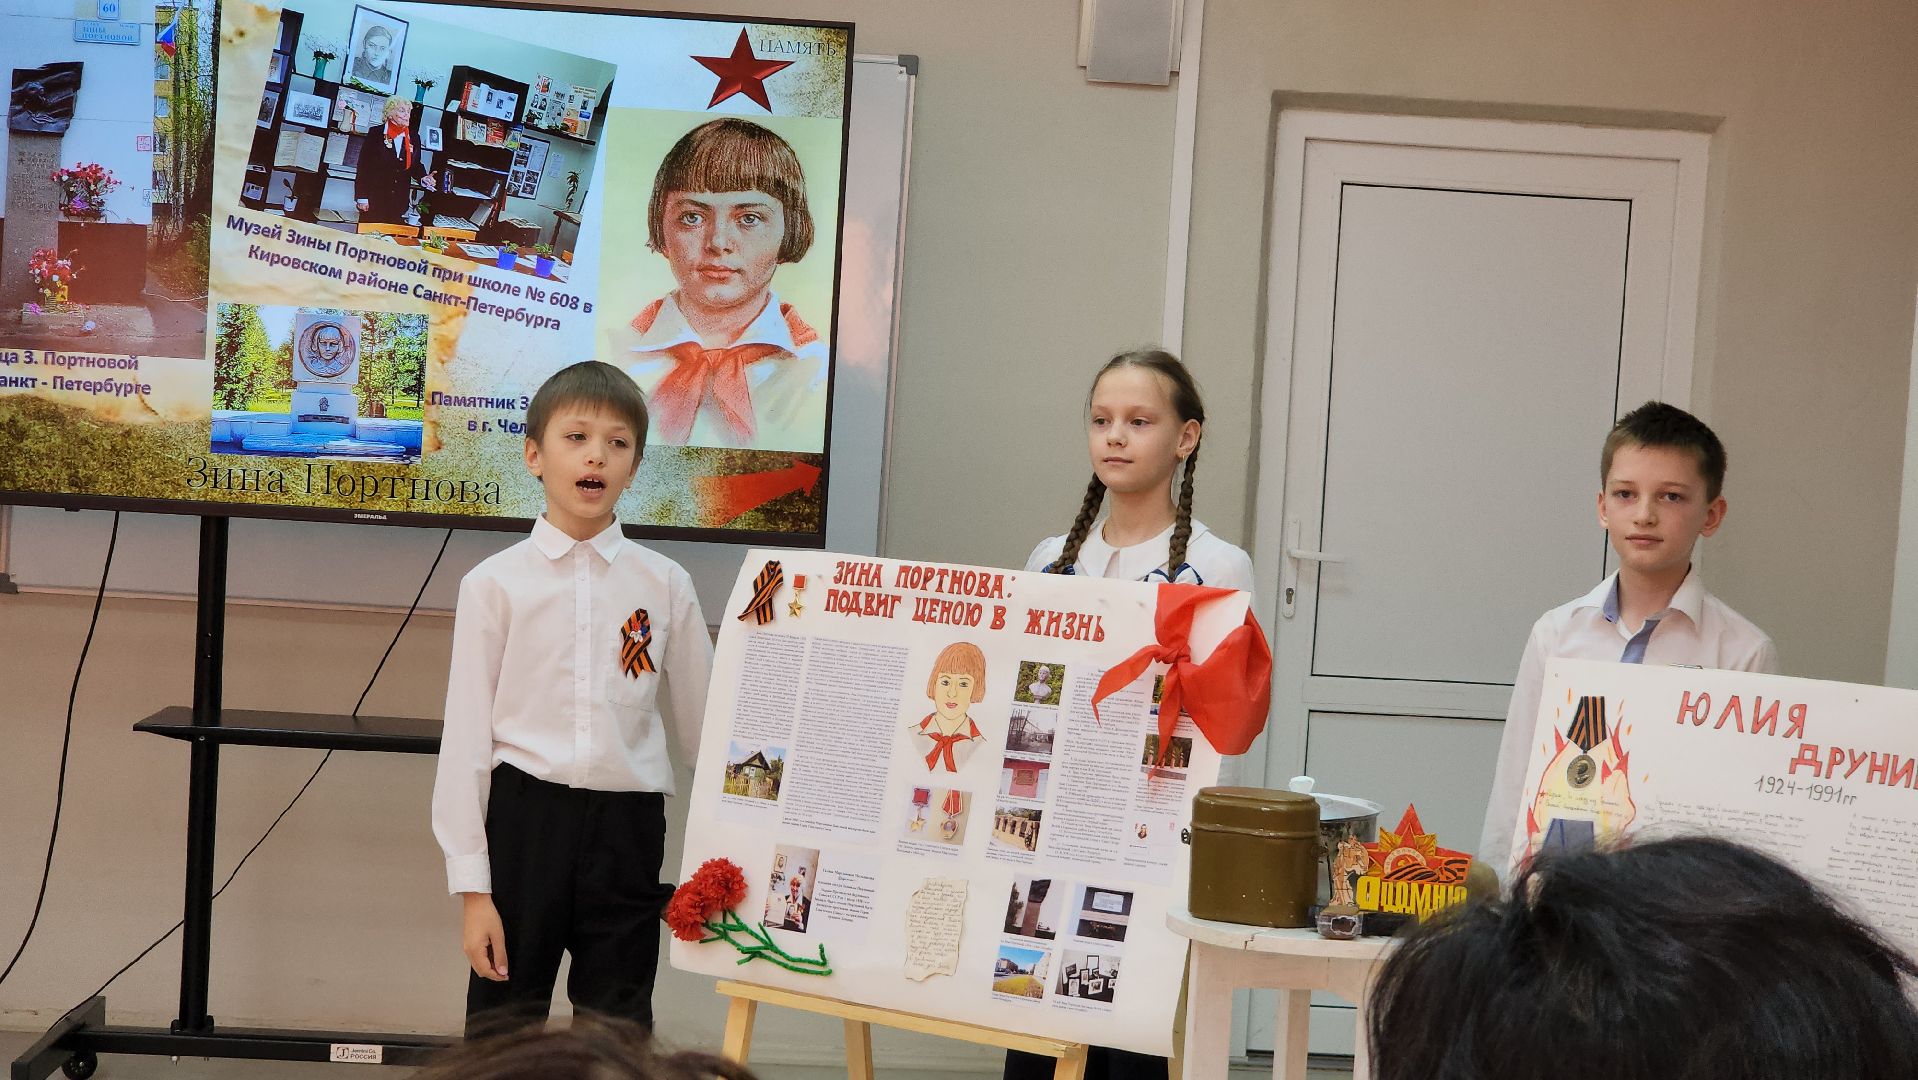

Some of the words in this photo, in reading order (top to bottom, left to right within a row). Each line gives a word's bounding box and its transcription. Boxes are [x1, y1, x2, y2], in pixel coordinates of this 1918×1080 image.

[103, 3, 116, 13] 60
[760, 39, 836, 56] ПАМЯТЬ
[226, 214, 281, 242] Музей
[286, 229, 331, 253] Зины
[335, 240, 429, 276] Портновой
[432, 262, 463, 284] при
[467, 274, 521, 298] школе
[525, 280, 546, 303] №
[549, 291, 580, 311] 608
[583, 300, 594, 314] в
[248, 244, 343, 281] Кировском
[346, 269, 410, 297] районе
[412, 283, 562, 332] Санкт-Петербурга
[23, 350, 38, 365] З.
[44, 350, 139, 371] Портновой
[52, 375, 152, 397] Петербурге
[431, 391, 516, 410] Памятник
[467, 420, 478, 432] в
[481, 421, 493, 432] г.
[186, 455, 288, 494] Зина
[303, 462, 501, 505] Портнова
[833, 560, 883, 588] ЗИНА
[895, 564, 1016, 600] ПОРТНОВА:
[824, 589, 903, 619] ПОДВИГ
[911, 596, 983, 628] ЦЕНОЮ
[989, 605, 1007, 631] В
[1023, 607, 1106, 644] ЖИЗНЬ
[1676, 689, 1808, 740] ЮЛИЯ
